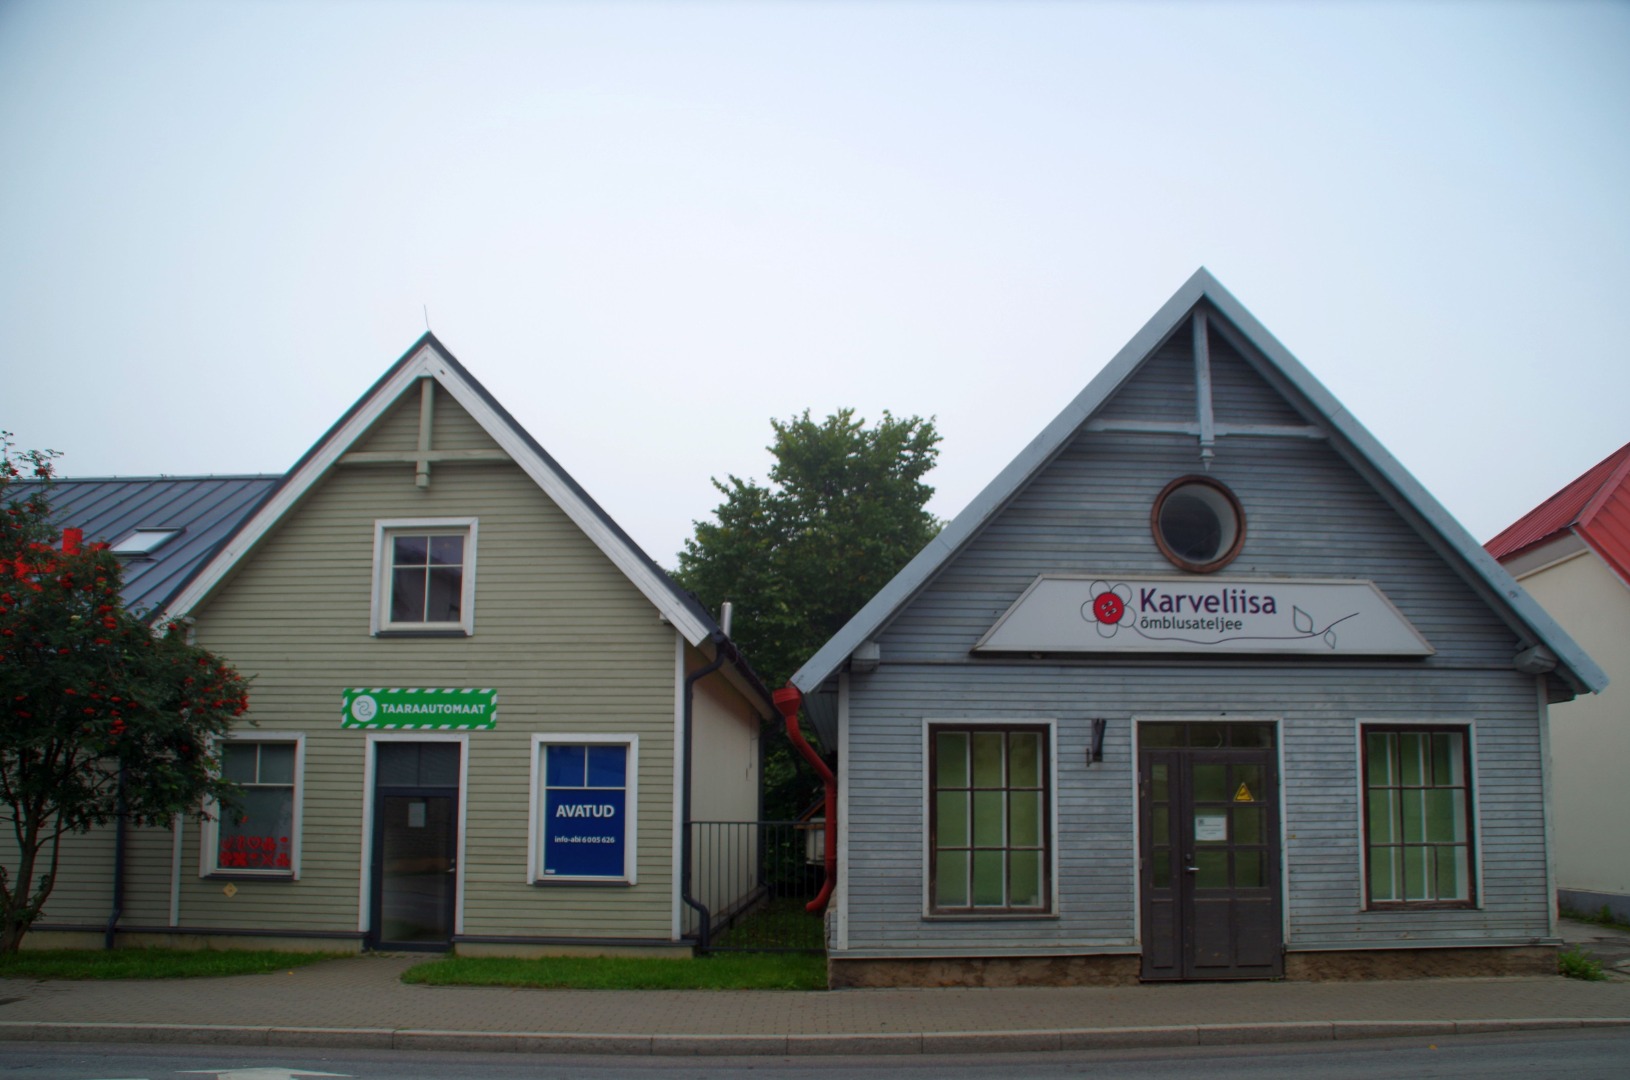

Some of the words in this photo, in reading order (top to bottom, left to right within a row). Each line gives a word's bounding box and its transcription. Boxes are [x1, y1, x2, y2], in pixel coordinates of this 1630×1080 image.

[1140, 587, 1277, 614] Karveliisa
[1140, 616, 1243, 633] õmblusateljee
[381, 703, 486, 714] TAARAAUTOMAAT
[555, 804, 615, 818] AVATUD
[554, 835, 581, 843] info-abi
